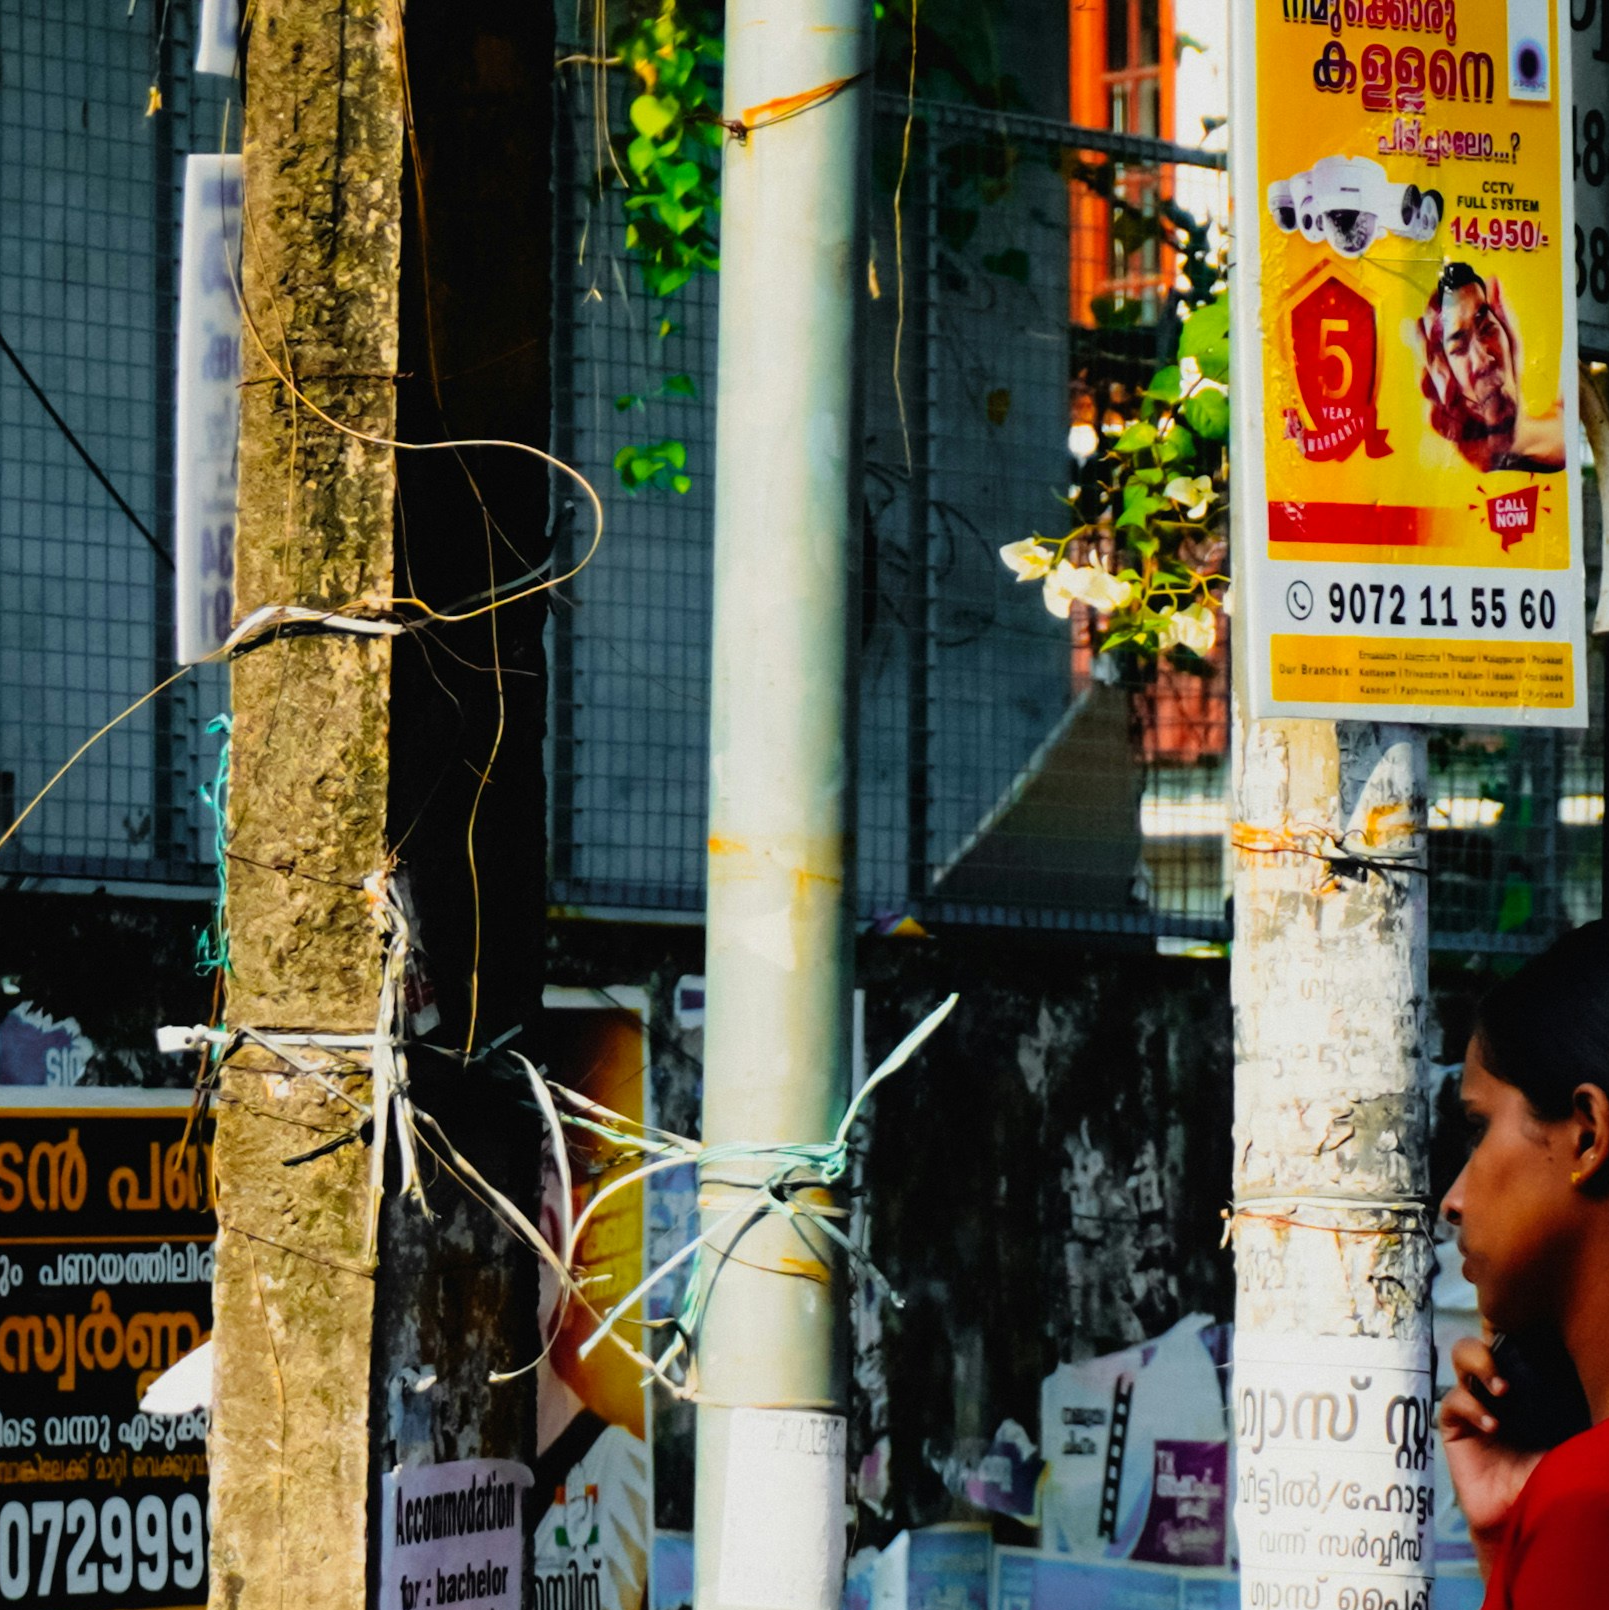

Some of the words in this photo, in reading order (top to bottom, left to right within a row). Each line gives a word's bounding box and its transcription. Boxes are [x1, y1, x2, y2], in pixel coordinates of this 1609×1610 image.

[1313, 40, 1494, 113] കള്ളനെ
[1457, 195, 1488, 210] FULL
[1491, 197, 1539, 213] SYSTEM
[1482, 181, 1514, 195] CCTV
[1450, 217, 1549, 250] 14,950/-
[1318, 319, 1353, 399] 5
[1321, 406, 1352, 420] YEAR
[1306, 416, 1365, 452] WARRANTY
[1495, 499, 1528, 513] CALL
[1495, 512, 1529, 528] NOW
[1329, 582, 1407, 625] 9072
[1419, 585, 1458, 627] 11
[1471, 588, 1507, 629] 55
[1520, 589, 1556, 629] 60
[1278, 664, 1298, 675] Our
[1240, 1375, 1372, 1455] ഗ്യാസ്
[45, 1414, 111, 1454] വന്നു
[395, 1472, 516, 1547] Accommodation
[436, 1563, 509, 1606] bachelor
